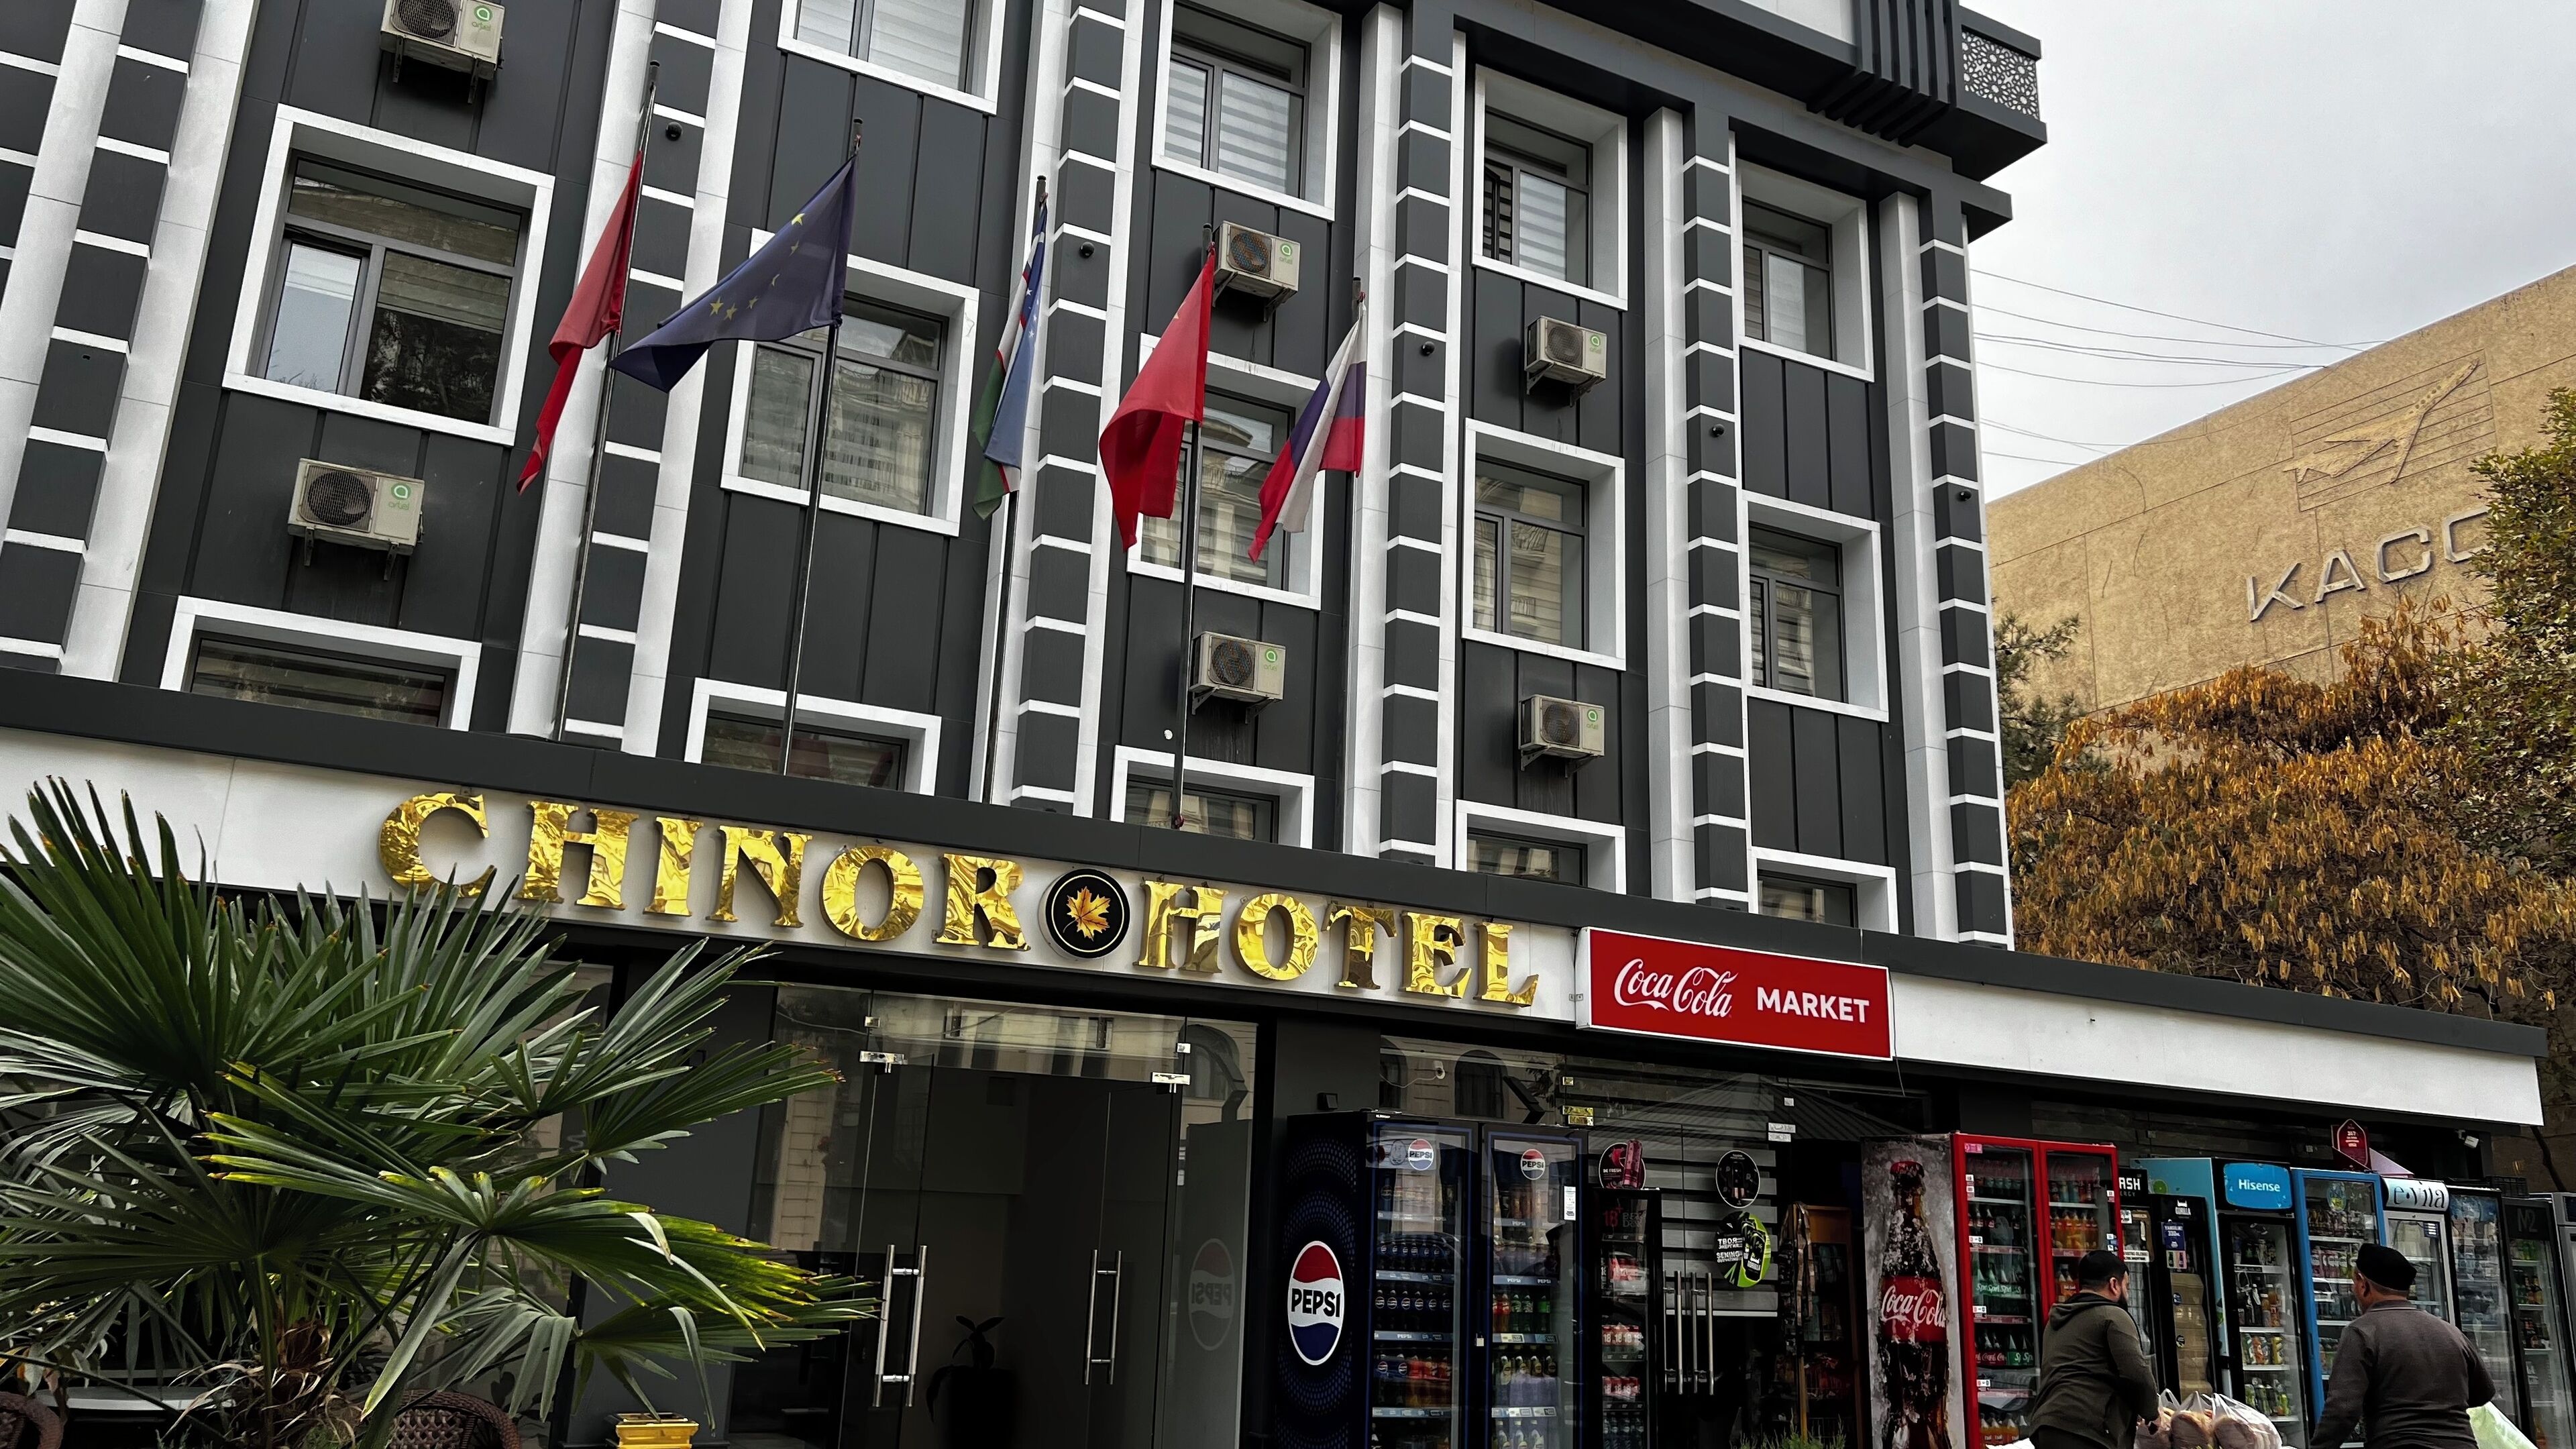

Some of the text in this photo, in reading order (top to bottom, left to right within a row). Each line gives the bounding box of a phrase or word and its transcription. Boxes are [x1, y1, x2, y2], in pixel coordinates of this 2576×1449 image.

[379, 792, 1540, 1008] CHINOR HOTEL
[1614, 958, 1870, 1023] Coca Cola MARKET
[1409, 1150, 1432, 1159] PEPSI
[1522, 1161, 1544, 1169] PEPSI
[2118, 1177, 2141, 1191] ASH
[2239, 1179, 2280, 1192] Hisense
[1291, 1287, 1341, 1318] PEPSI
